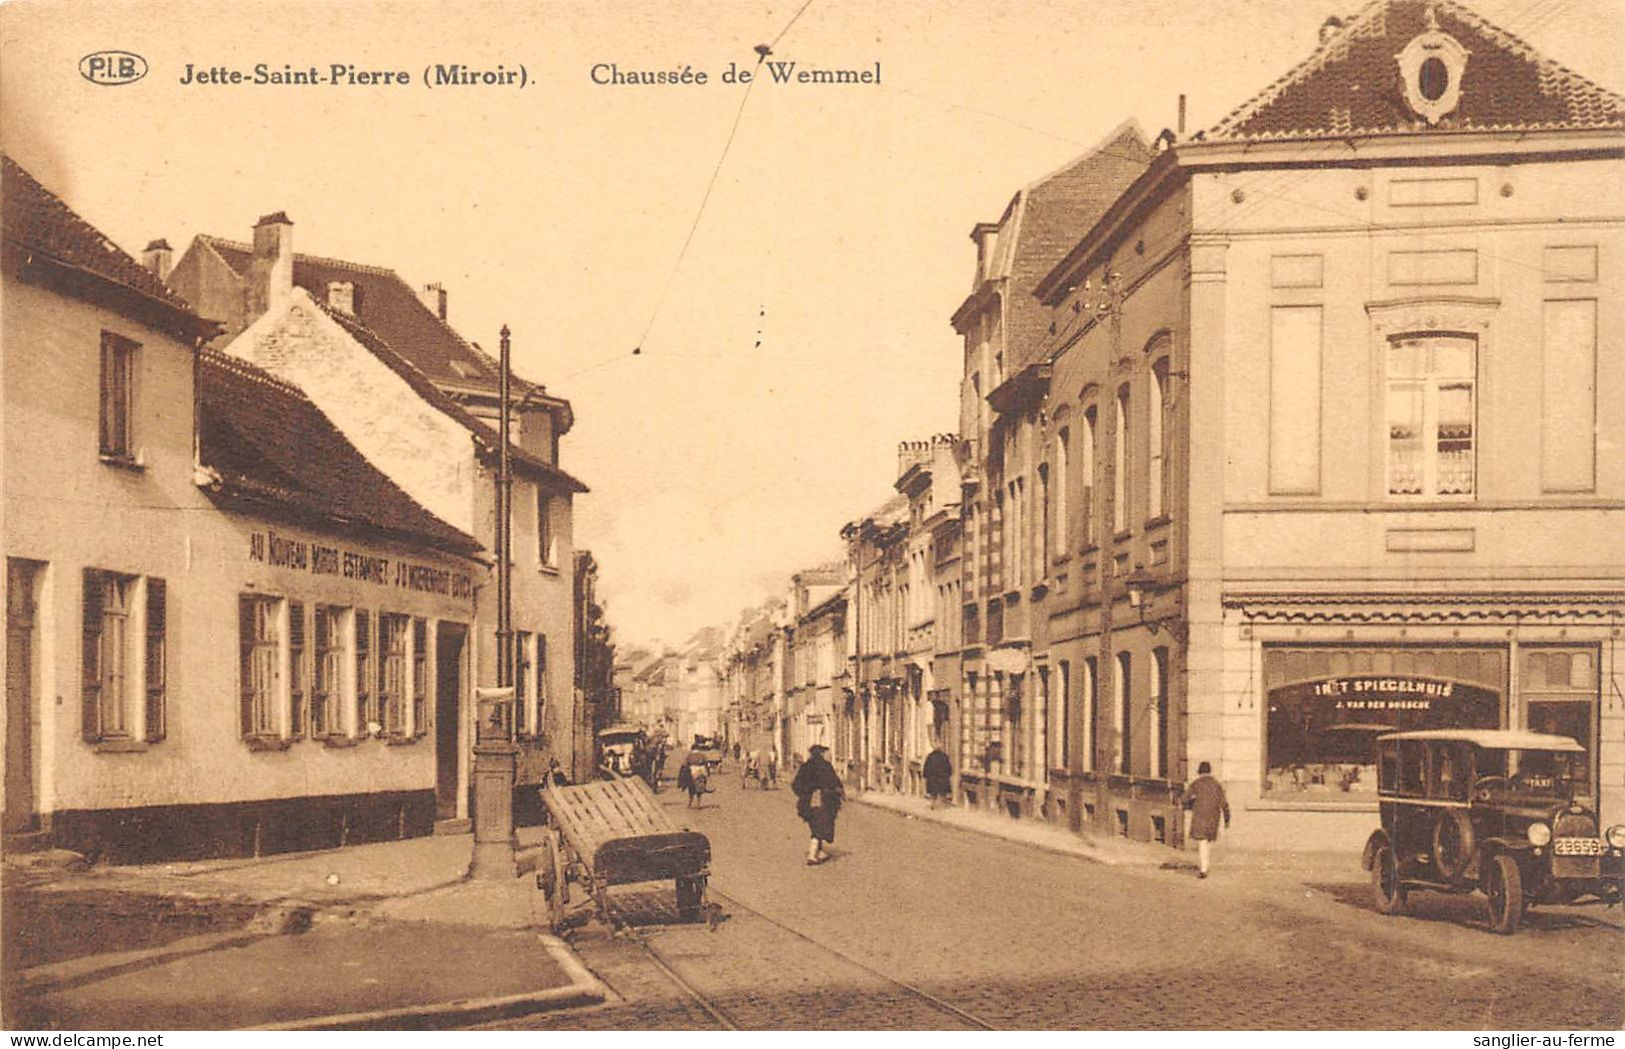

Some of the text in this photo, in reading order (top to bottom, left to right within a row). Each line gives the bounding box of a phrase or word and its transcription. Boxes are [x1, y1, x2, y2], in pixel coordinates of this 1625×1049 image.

[250, 532, 264, 562] AU
[1354, 680, 1453, 698] SPIEGELHUIS
[1347, 700, 1365, 709] VAN
[1367, 700, 1386, 709] DEN
